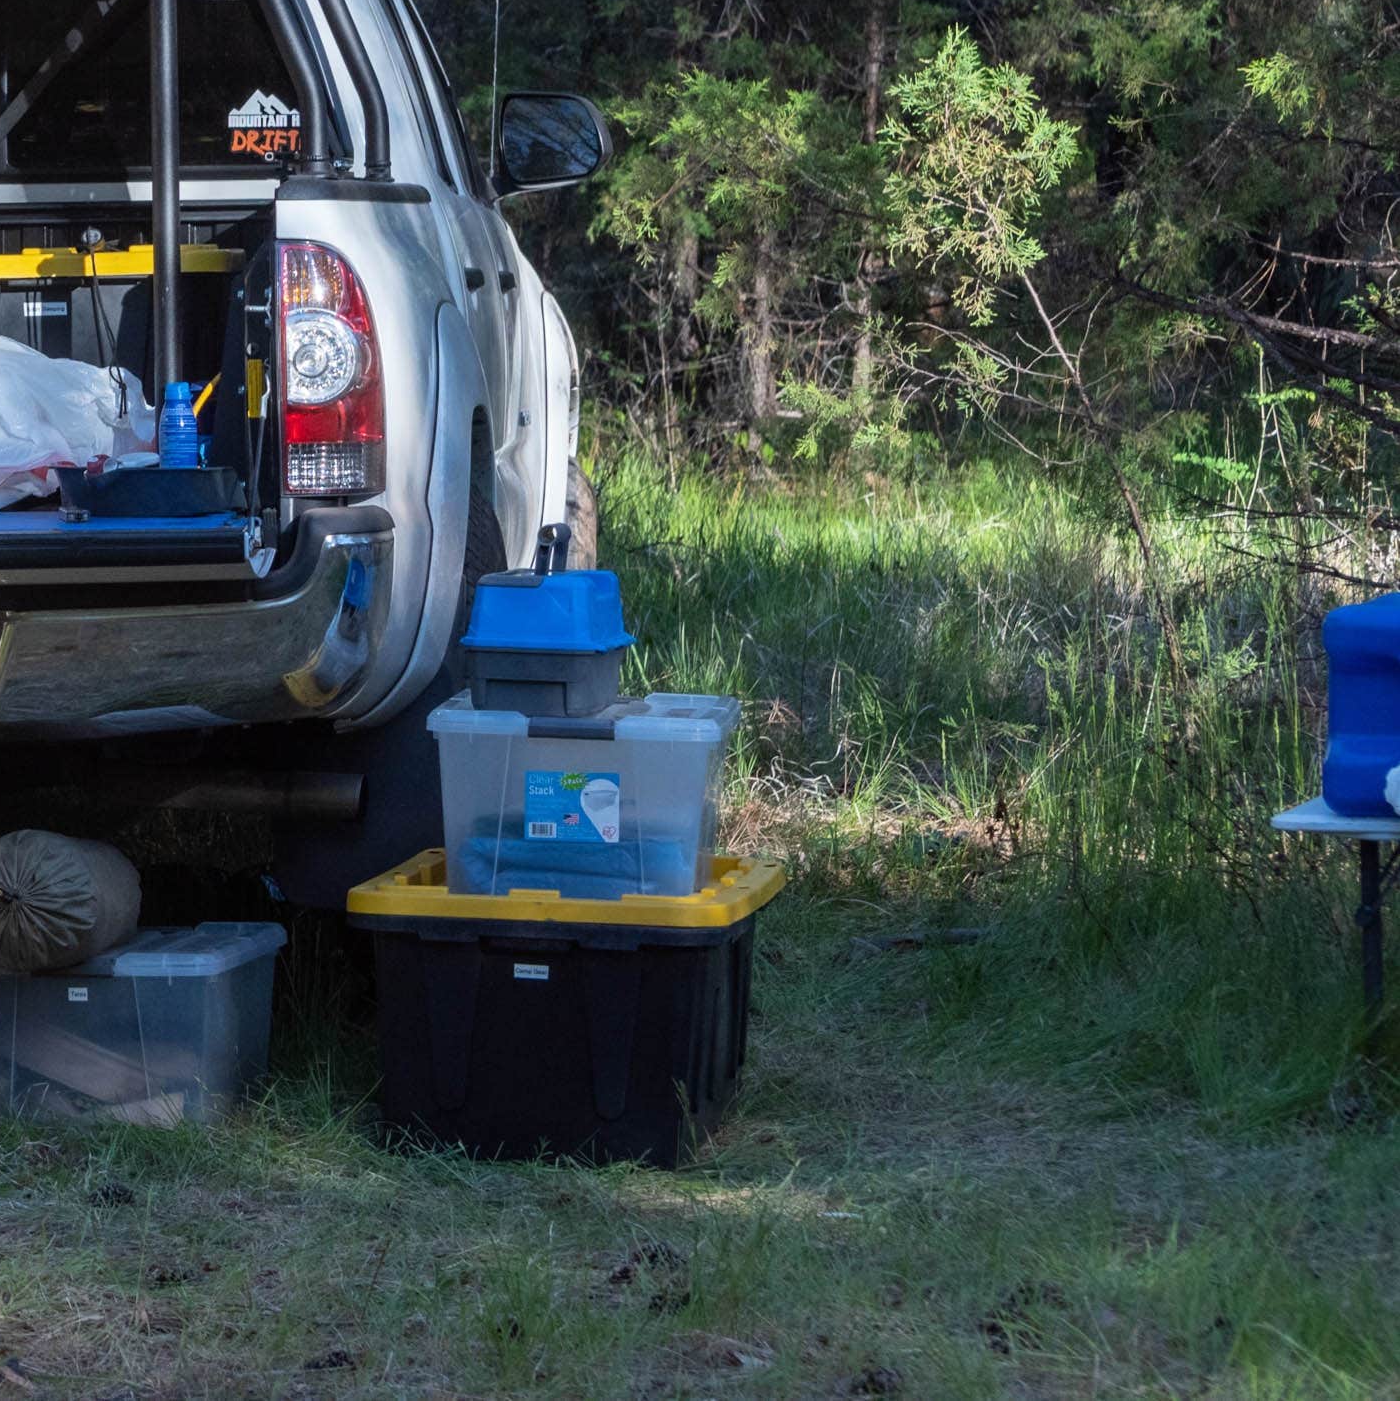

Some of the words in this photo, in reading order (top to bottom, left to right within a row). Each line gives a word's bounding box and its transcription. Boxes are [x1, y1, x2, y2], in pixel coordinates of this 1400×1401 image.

[231, 129, 301, 155] DRIFT
[528, 773, 553, 785] Clear
[528, 785, 555, 796] Stack
